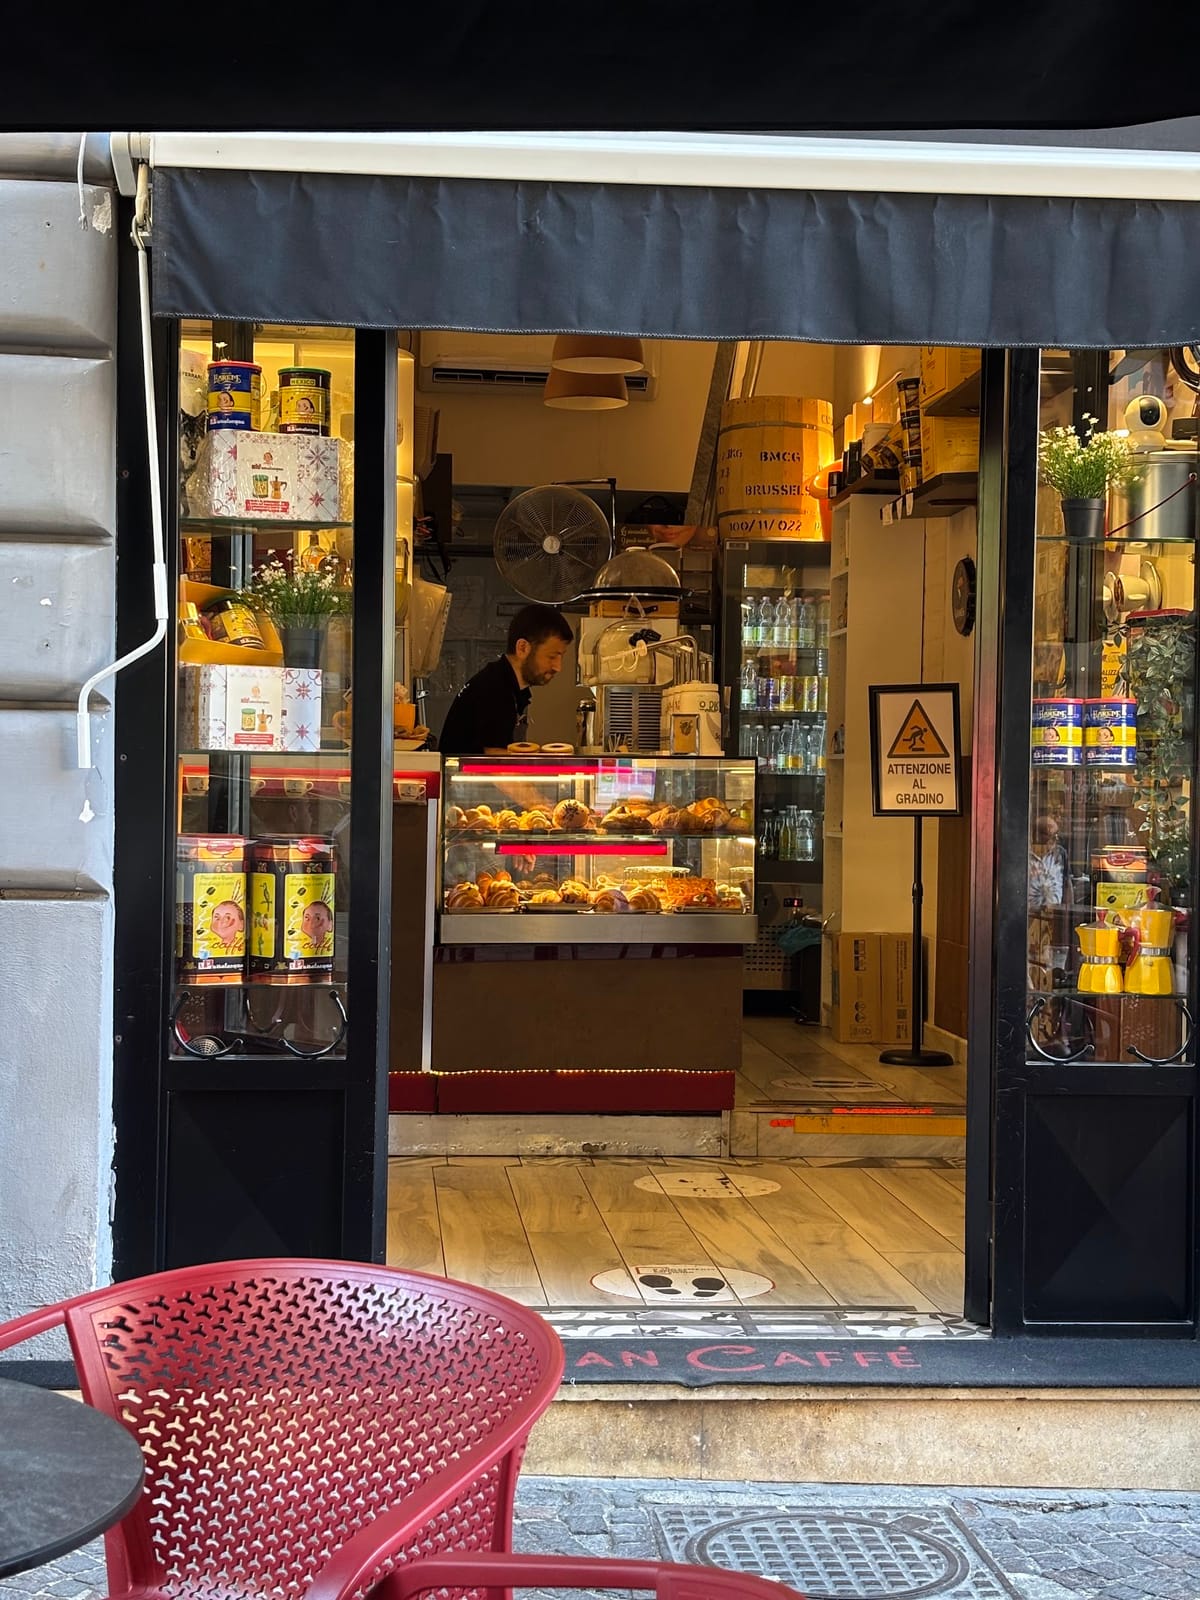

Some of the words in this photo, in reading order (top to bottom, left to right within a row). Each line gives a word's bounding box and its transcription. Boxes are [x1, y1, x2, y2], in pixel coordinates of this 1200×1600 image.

[760, 451, 801, 462] BMCG
[745, 484, 810, 496] BRUSSELS
[887, 763, 952, 775] ATTENZIONE
[912, 778, 927, 789] AL
[895, 793, 944, 804] GRADINO
